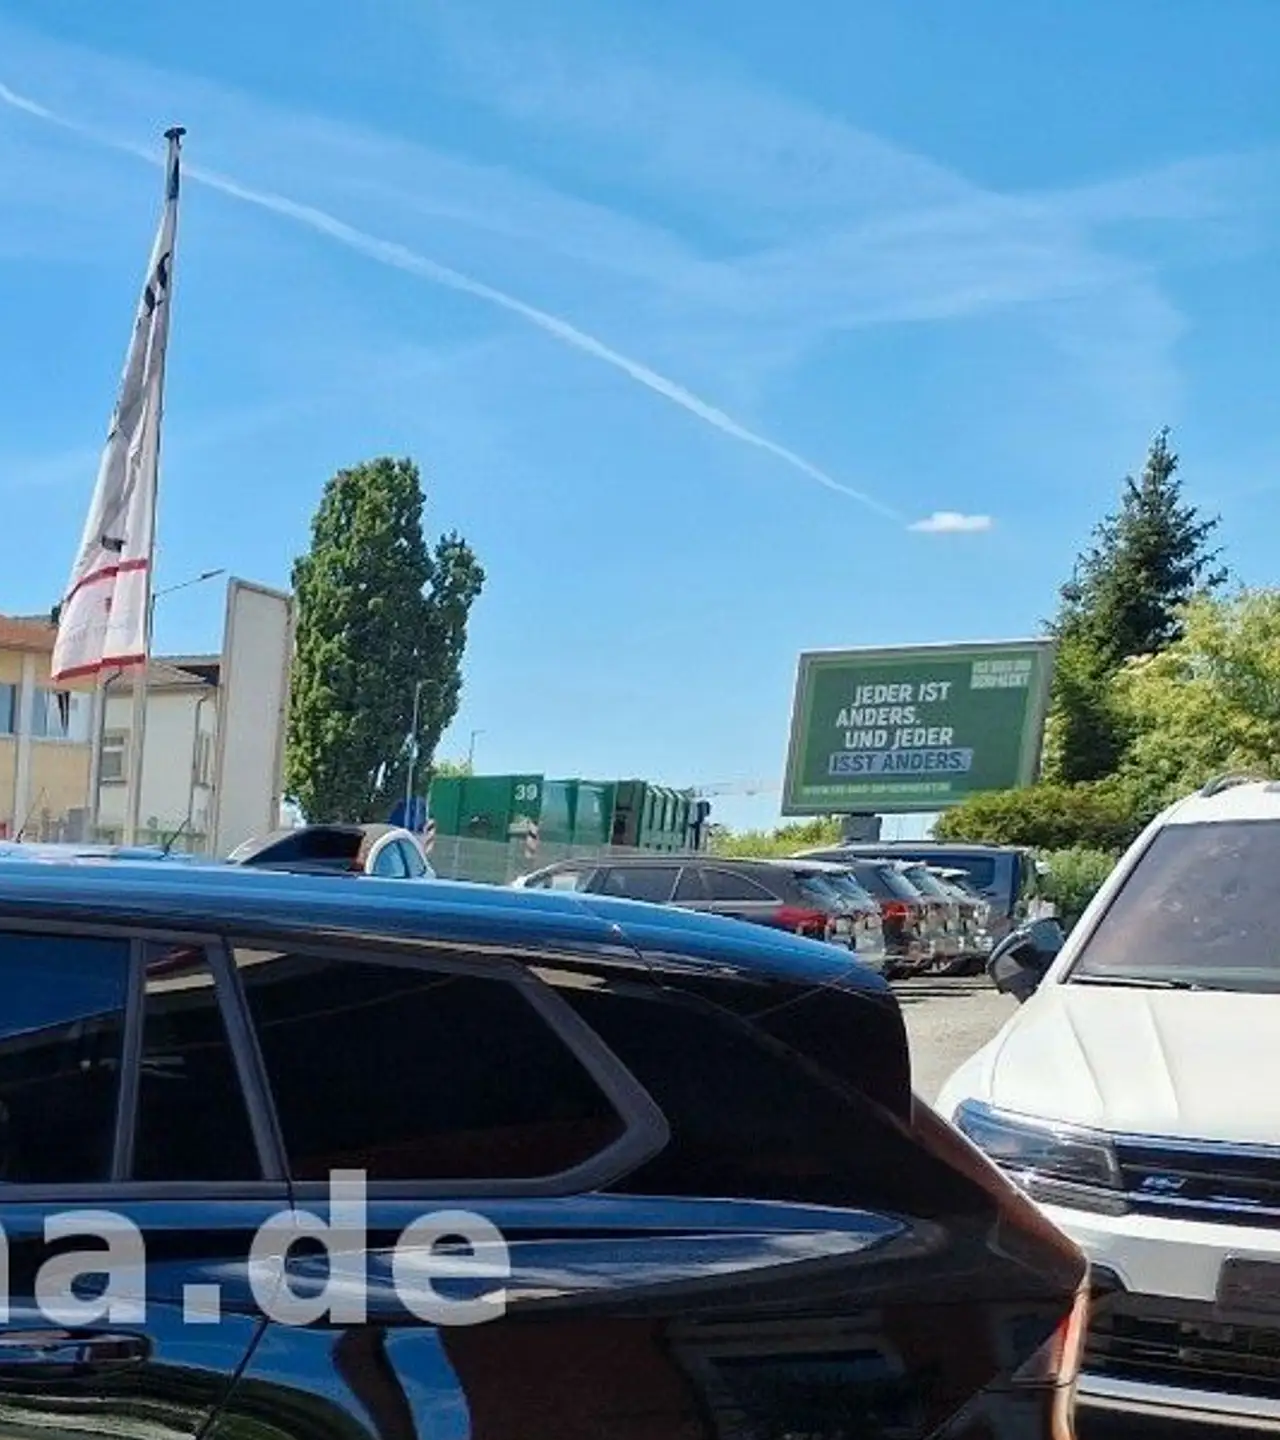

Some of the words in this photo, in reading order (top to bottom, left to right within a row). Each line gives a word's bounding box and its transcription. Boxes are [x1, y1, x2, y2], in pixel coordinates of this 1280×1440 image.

[852, 684, 914, 707] JEDER
[919, 681, 952, 702] IST
[836, 706, 922, 728] ANDERS.
[845, 730, 888, 749] UND
[891, 727, 954, 750] JEDER
[831, 754, 877, 772] ISST
[882, 751, 967, 771] ANDERS.
[514, 783, 539, 801] 39
